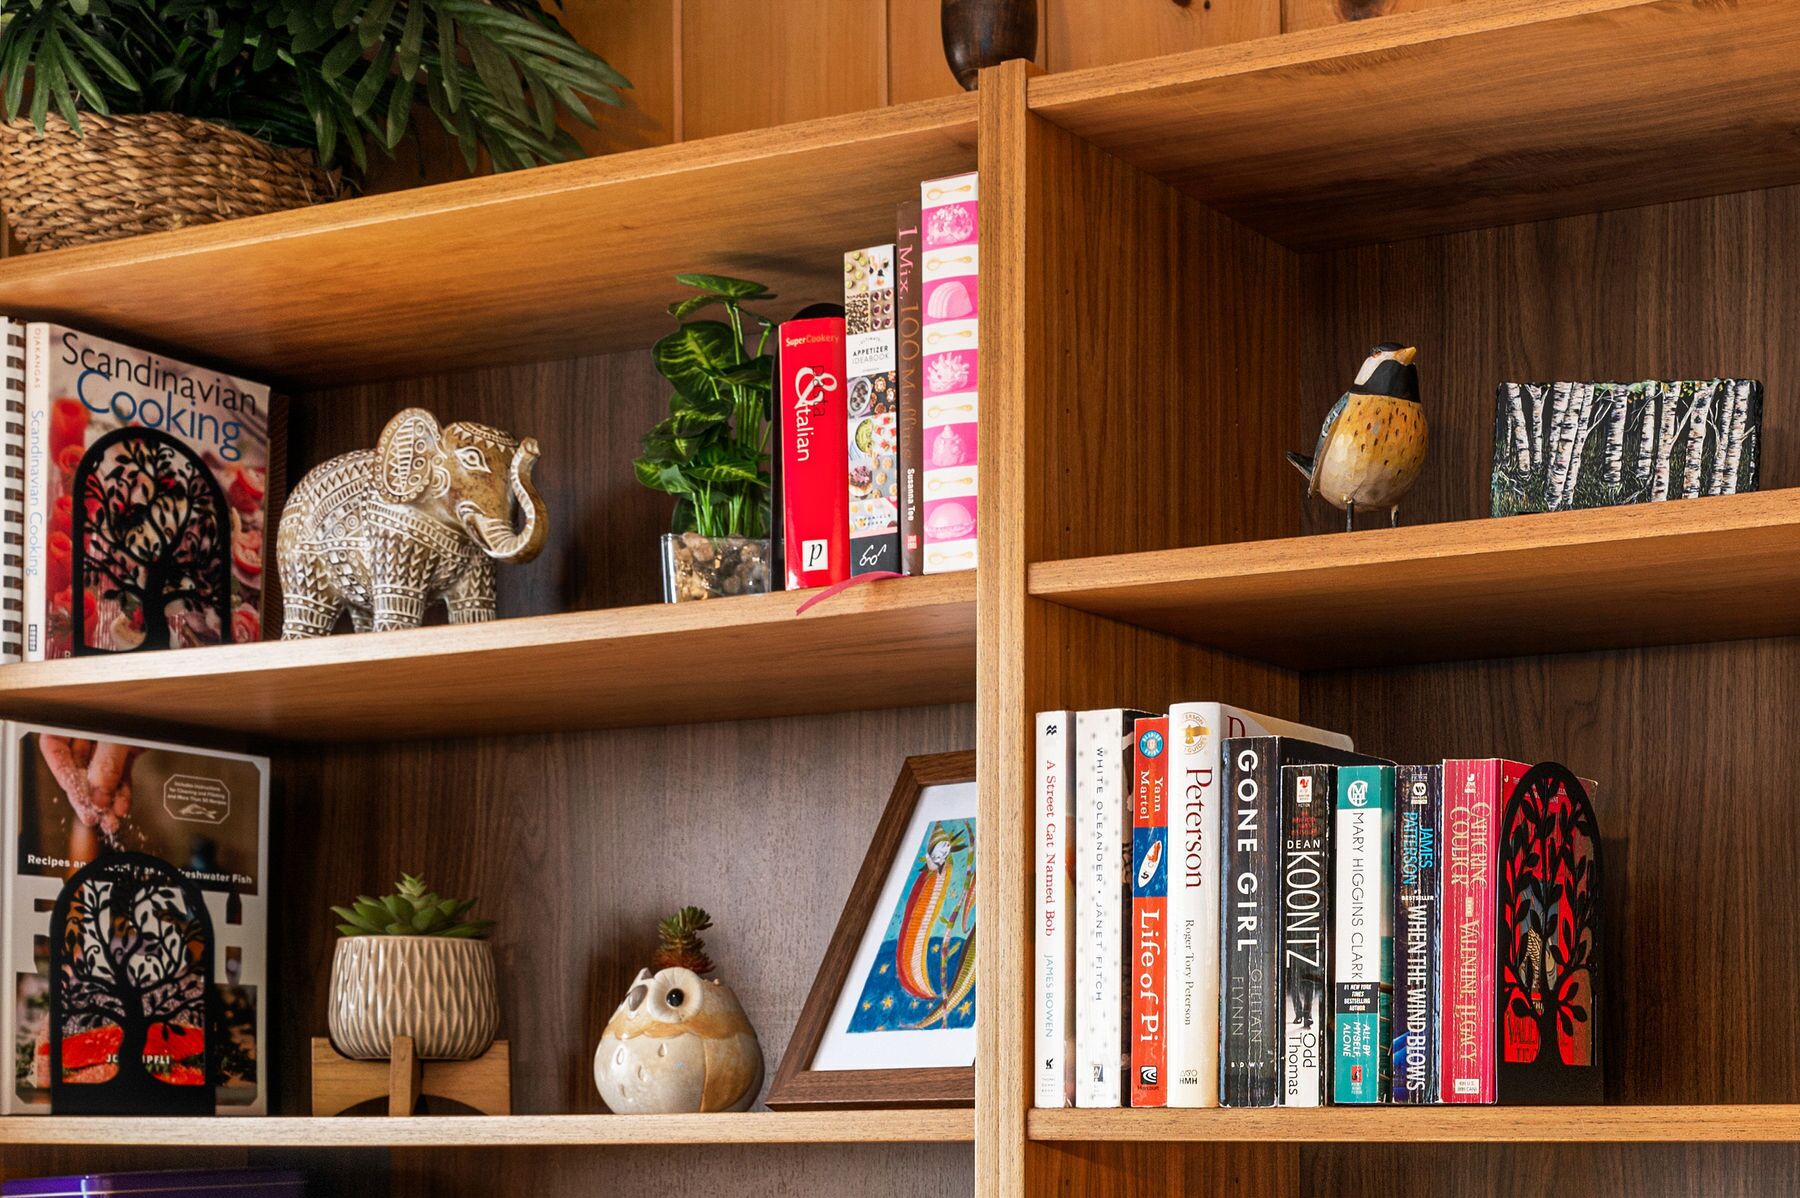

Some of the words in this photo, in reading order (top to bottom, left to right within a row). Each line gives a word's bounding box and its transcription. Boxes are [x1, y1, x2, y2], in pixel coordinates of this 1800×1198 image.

[852, 354, 888, 364] IDEABOOK
[853, 345, 888, 356] APPETIZER
[61, 331, 258, 415] Scandinavian
[76, 367, 242, 462] Cooking
[1046, 761, 1055, 771] A
[1046, 775, 1056, 814] Street
[1237, 750, 1259, 853] GONE
[1046, 821, 1056, 845] Cat
[1185, 767, 1213, 889] Peterson
[1287, 839, 1321, 849] DEAN
[1352, 812, 1363, 852] MARY
[1046, 853, 1056, 908] Named
[1352, 858, 1364, 927] HIGGINS
[1045, 912, 1056, 937] Bob
[1237, 872, 1258, 951] GIRL
[1286, 851, 1326, 967] KOONTZ
[1406, 904, 1428, 948] WHEN
[1140, 908, 1160, 959] Life
[1184, 919, 1194, 950] Roger
[1351, 931, 1363, 979] CLARK
[1140, 963, 1160, 998] of
[1183, 954, 1193, 978] Tory
[1407, 948, 1427, 982] THE
[1140, 1005, 1160, 1041] Pi
[1184, 980, 1193, 1025] Peterson
[1407, 986, 1427, 1033] WIND
[1406, 1035, 1426, 1091] BLOWS
